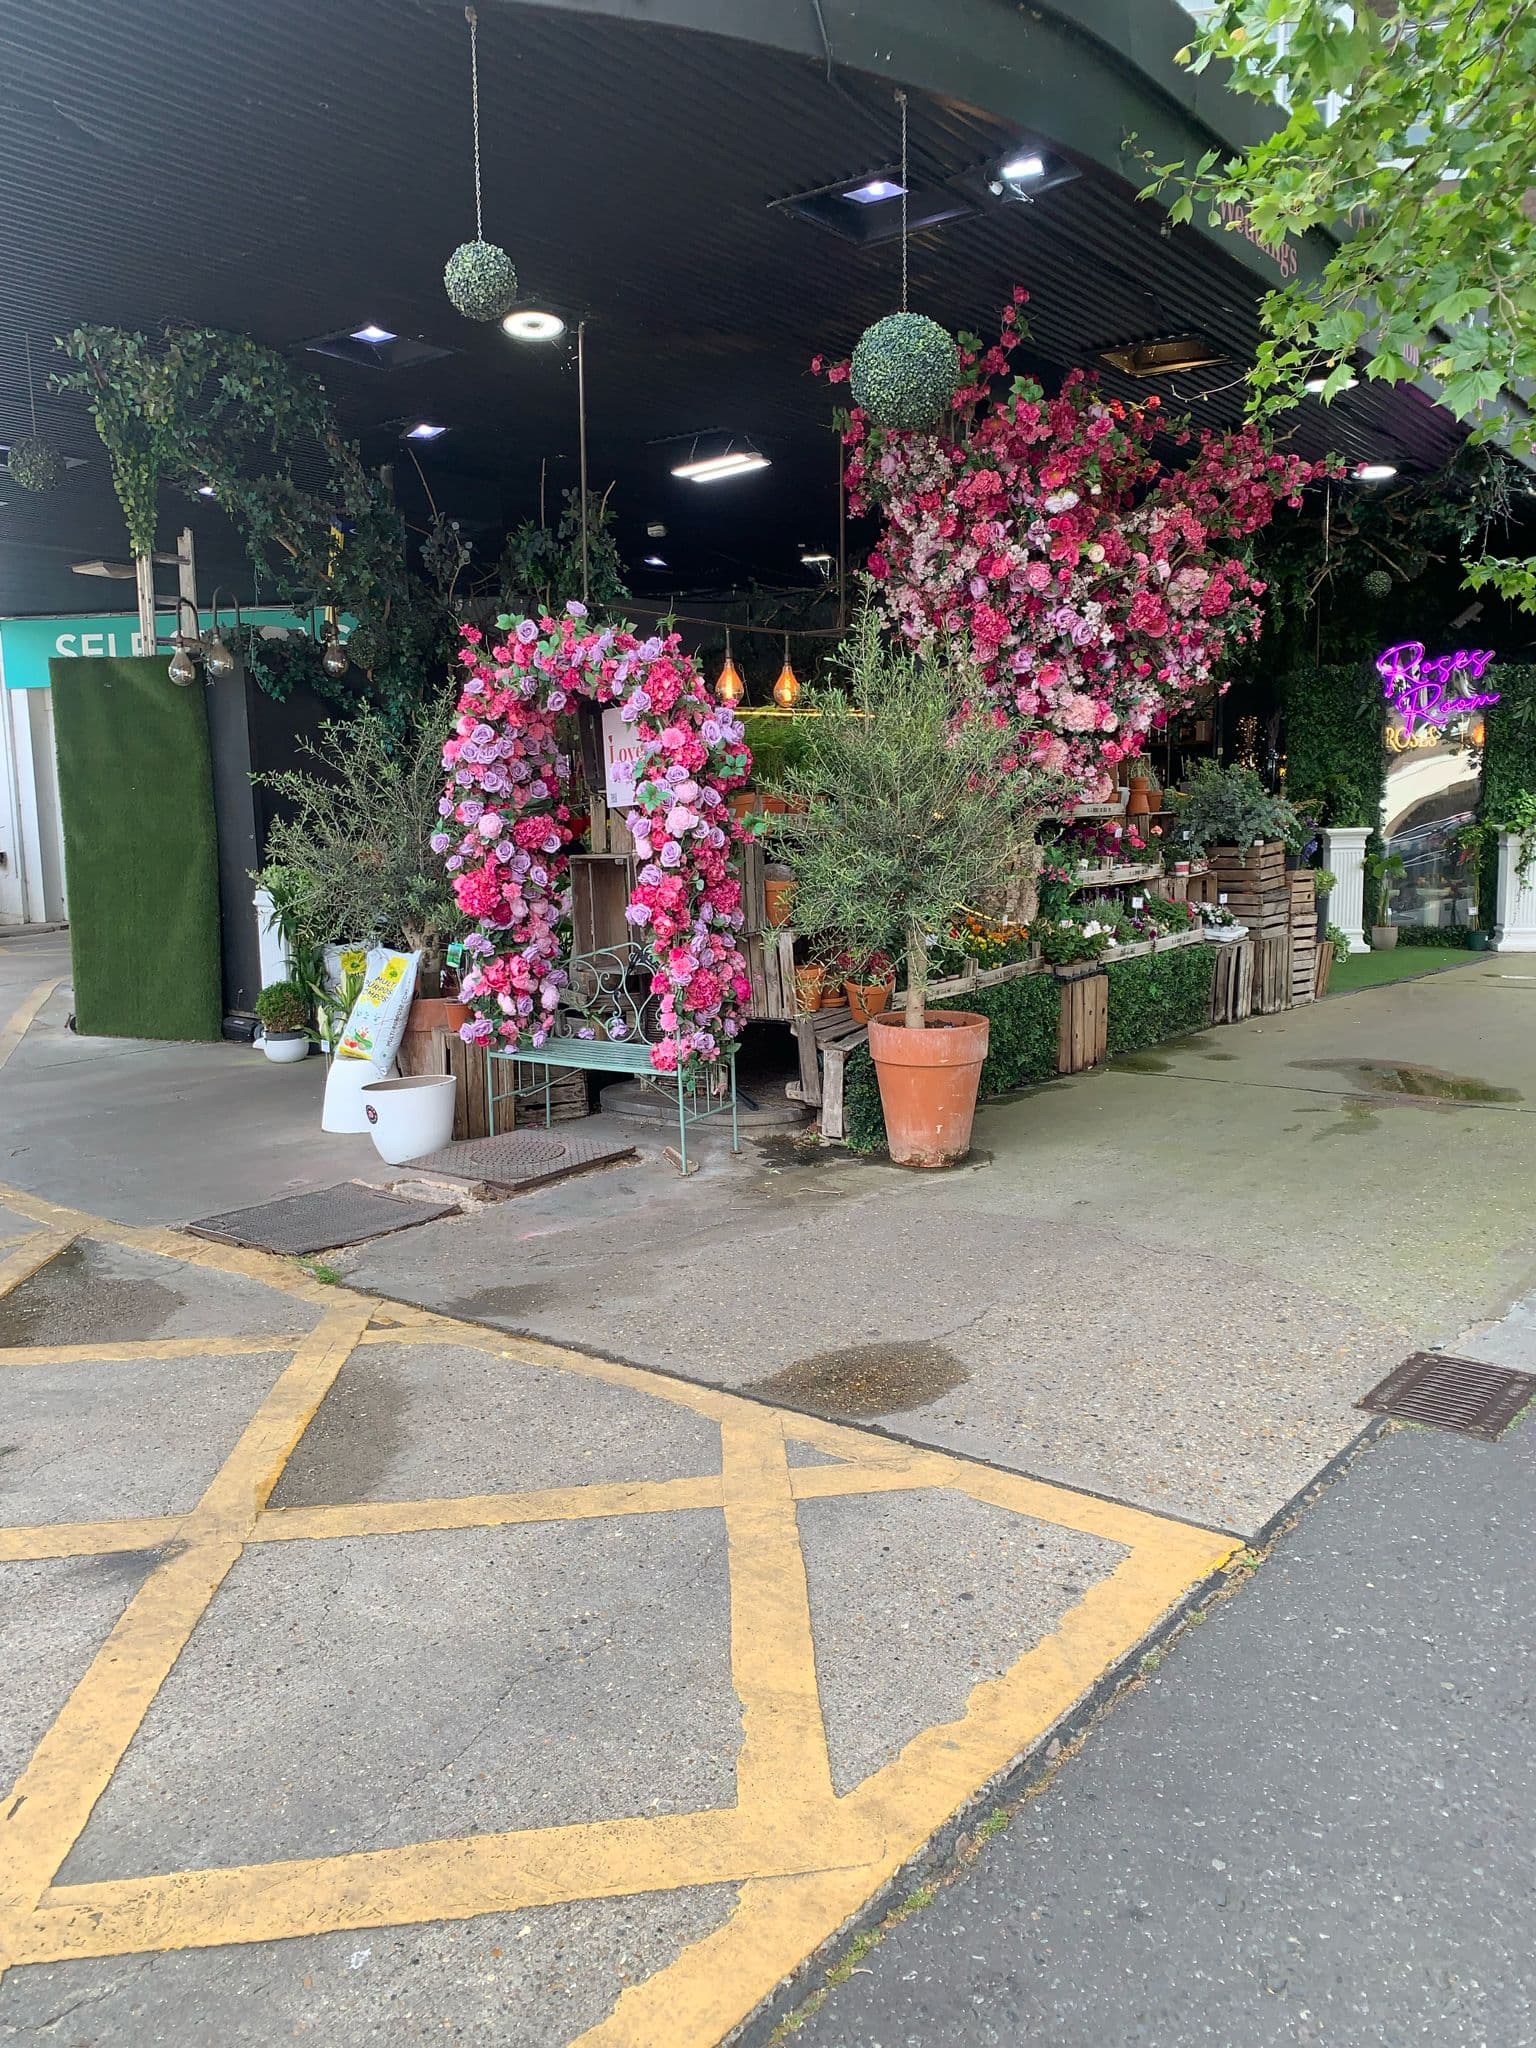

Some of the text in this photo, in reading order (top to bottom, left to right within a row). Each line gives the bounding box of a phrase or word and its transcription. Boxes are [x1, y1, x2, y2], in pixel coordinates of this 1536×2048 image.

[1221, 201, 1298, 278] Wengs
[1376, 641, 1496, 698] Roses
[1397, 683, 1502, 738] Room
